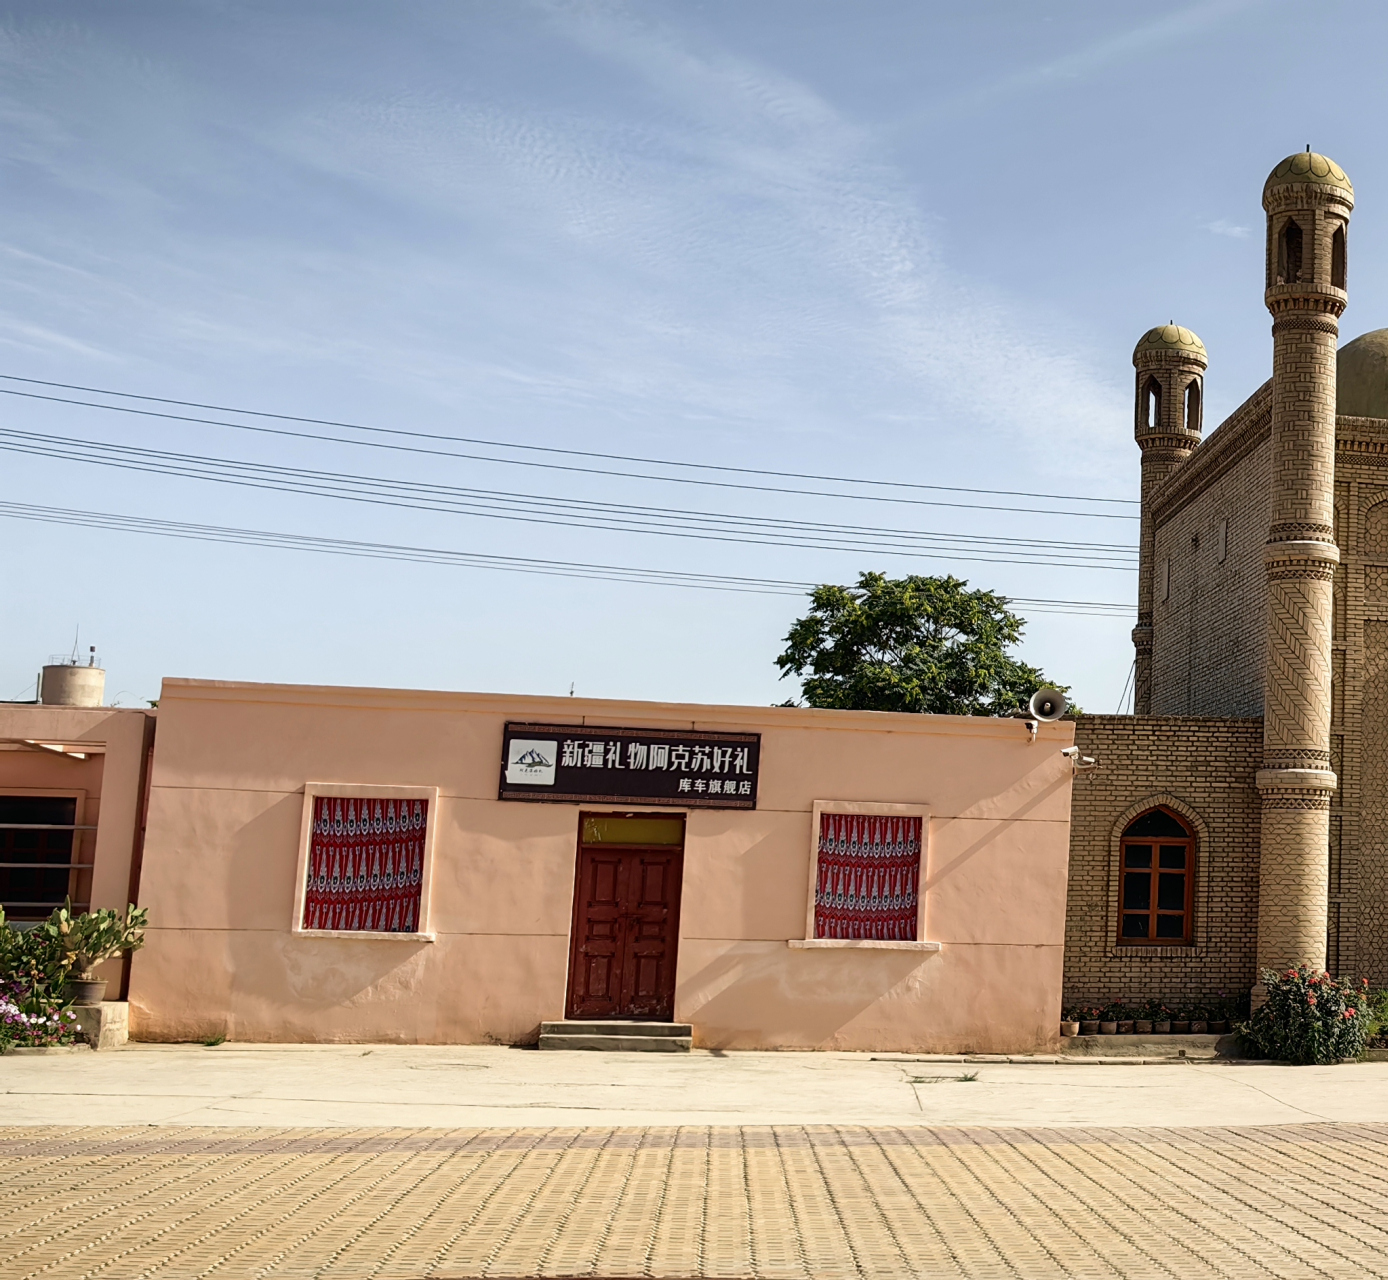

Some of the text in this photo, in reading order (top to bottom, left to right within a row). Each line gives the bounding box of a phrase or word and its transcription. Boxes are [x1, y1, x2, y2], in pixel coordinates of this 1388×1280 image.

[561, 740, 753, 775] 新疆礼物阿克苏好礼
[677, 778, 752, 795] 库车旗舰店
